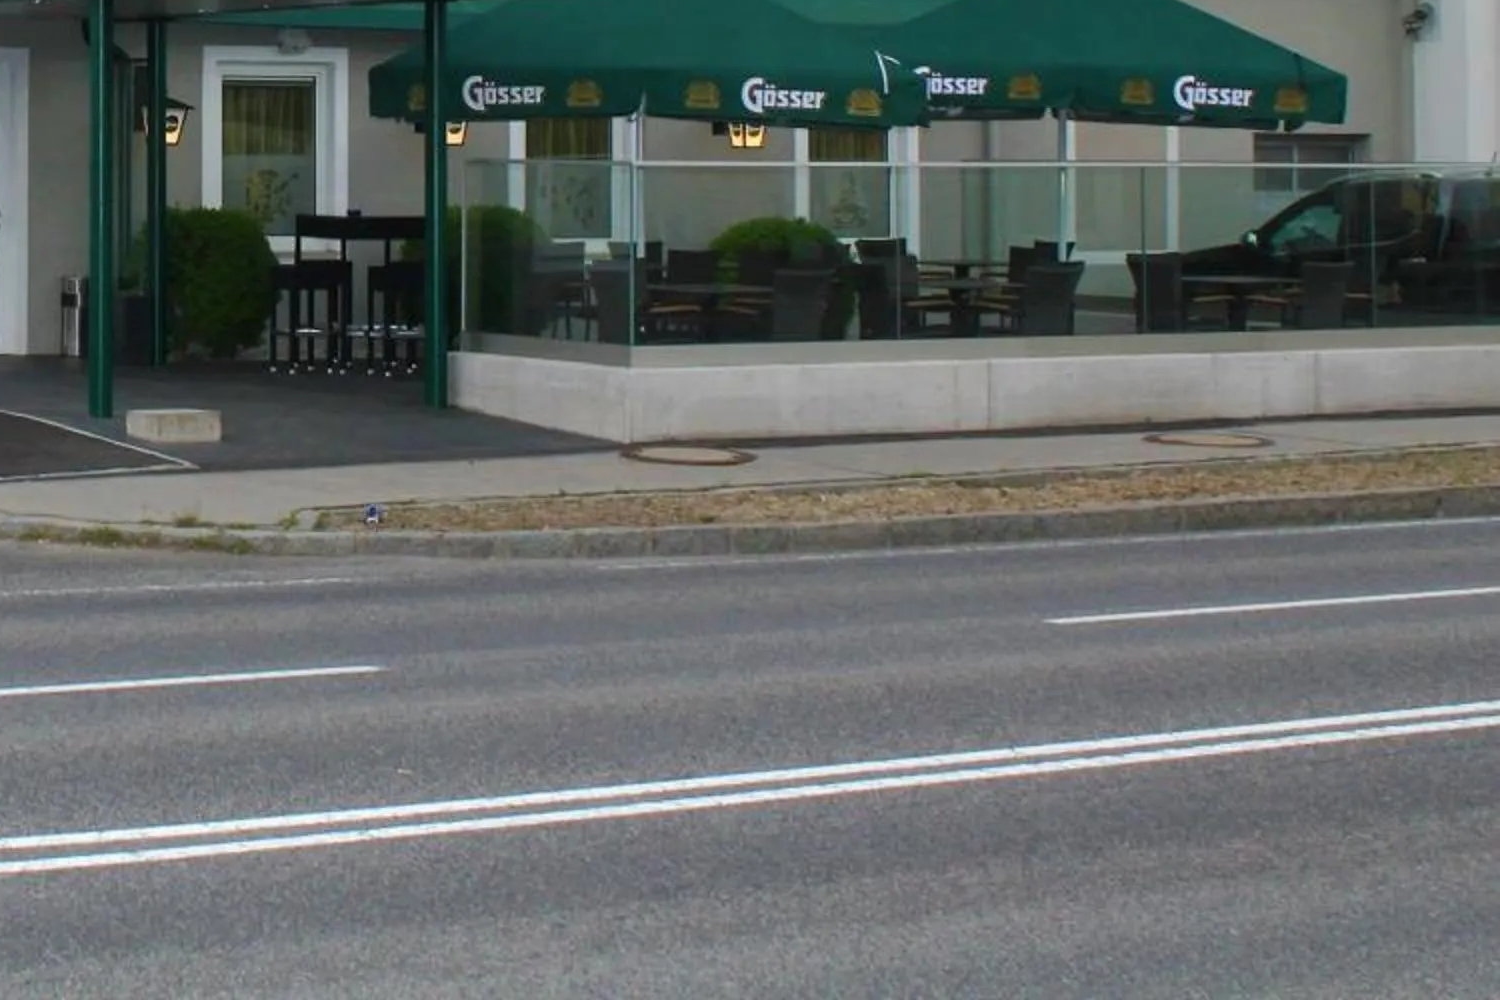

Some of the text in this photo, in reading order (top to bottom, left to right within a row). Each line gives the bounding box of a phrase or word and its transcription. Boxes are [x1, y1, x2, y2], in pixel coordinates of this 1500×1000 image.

[461, 75, 546, 111] Gösser
[741, 76, 828, 113] Gösser
[1173, 75, 1254, 111] Gösser
